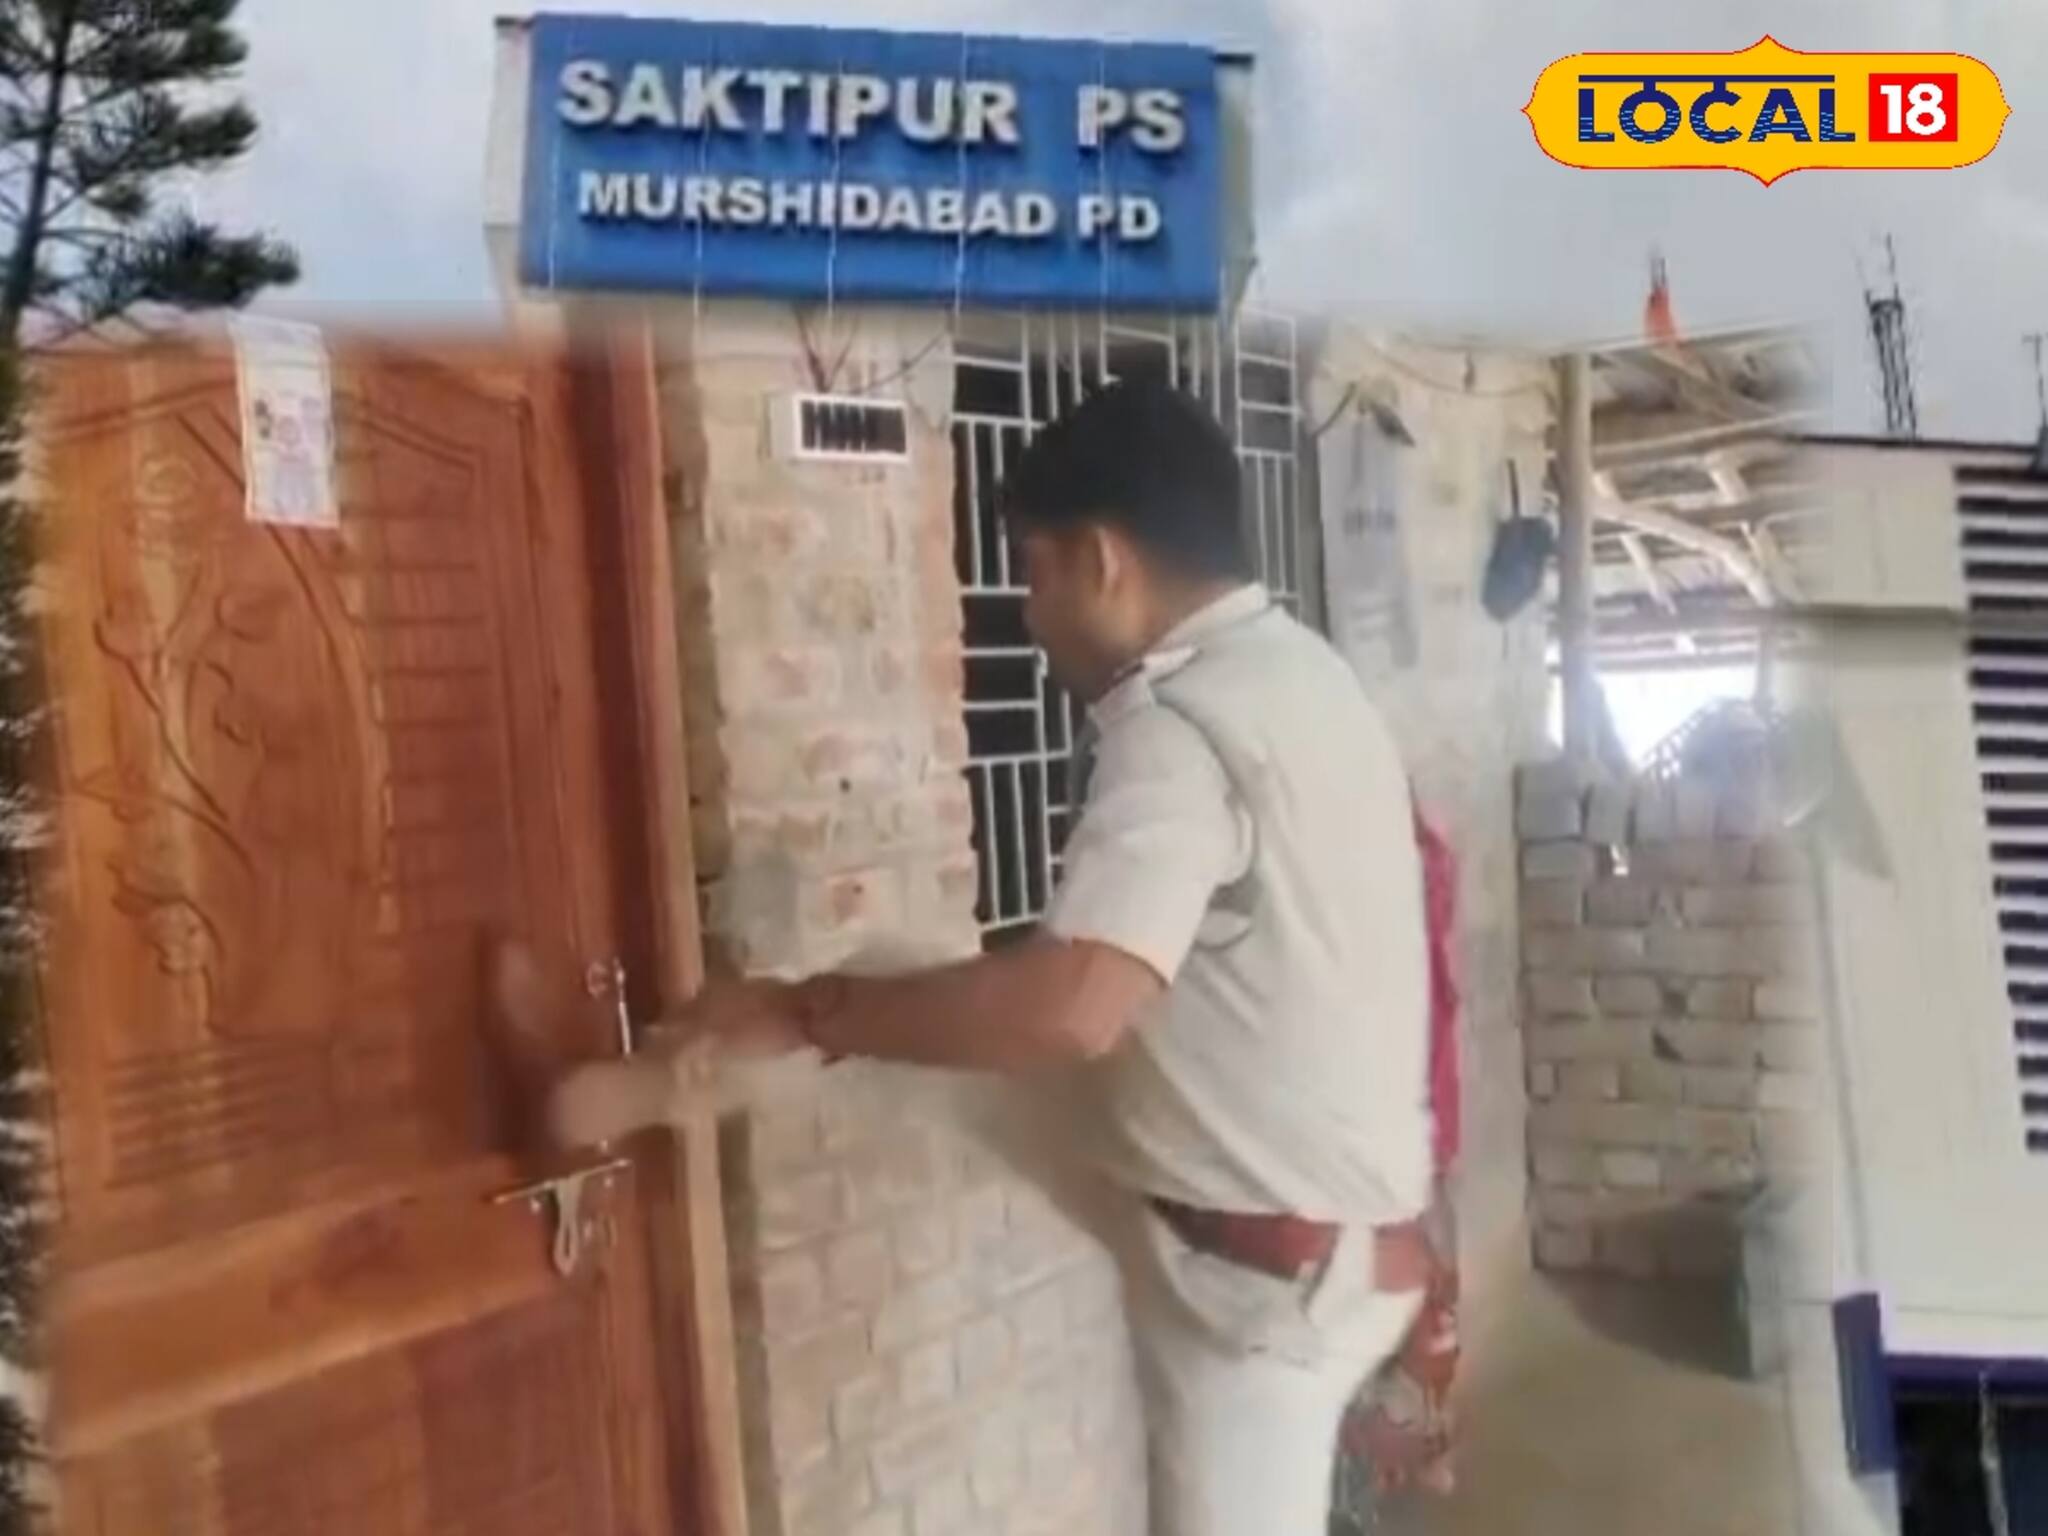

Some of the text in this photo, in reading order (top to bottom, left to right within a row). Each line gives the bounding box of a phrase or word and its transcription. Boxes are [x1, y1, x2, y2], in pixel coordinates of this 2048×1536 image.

[558, 59, 1187, 152] SAKTIPUR PS
[577, 170, 1163, 243] MURSHIDABAD PD
